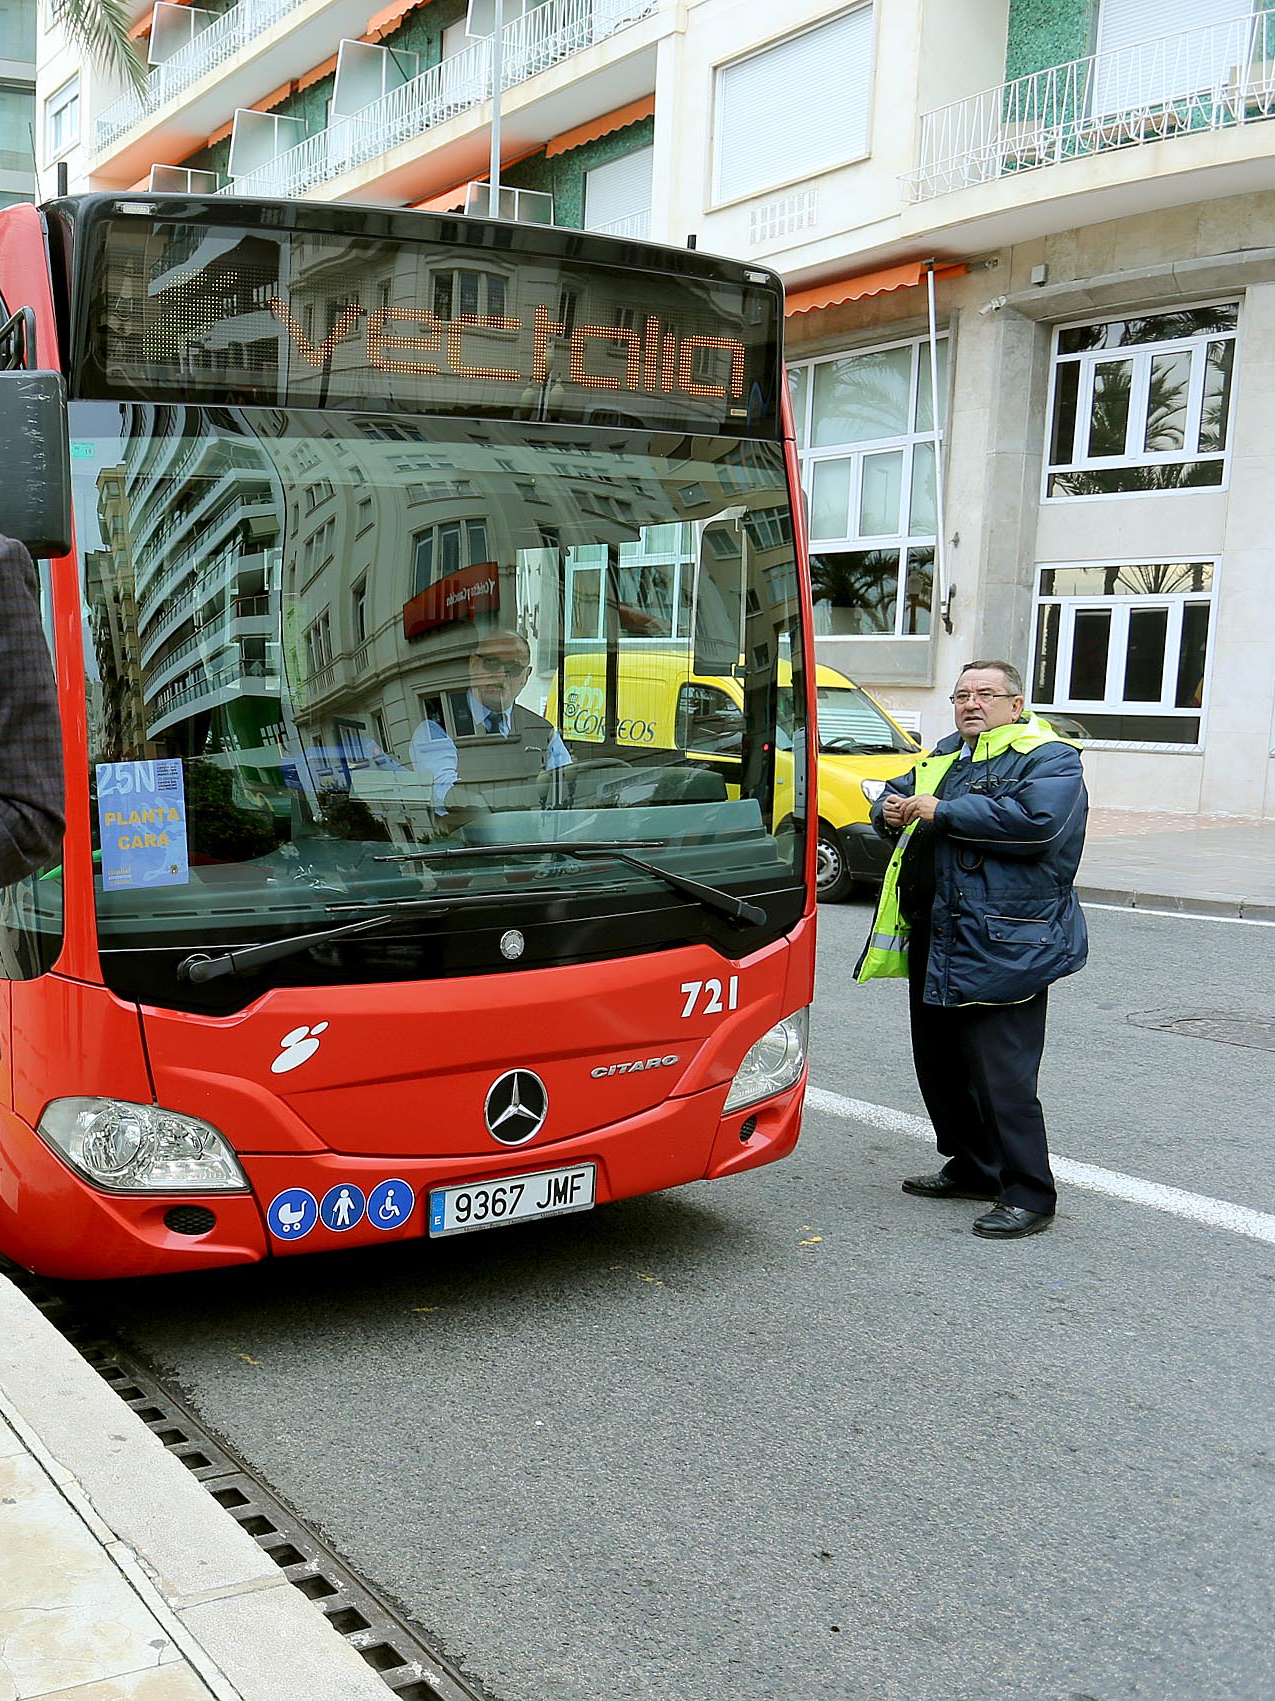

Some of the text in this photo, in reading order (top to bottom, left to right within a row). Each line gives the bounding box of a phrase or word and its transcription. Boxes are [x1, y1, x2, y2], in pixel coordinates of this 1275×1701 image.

[268, 295, 746, 399] vectalia
[96, 760, 156, 798] 25N
[104, 807, 181, 827] PLANTA
[117, 833, 170, 850] CARA
[680, 975, 739, 1018] 721
[590, 1054, 679, 1079] CITARO
[434, 1215, 442, 1225] E
[454, 1183, 526, 1224] 9367
[535, 1172, 586, 1209] JMF
